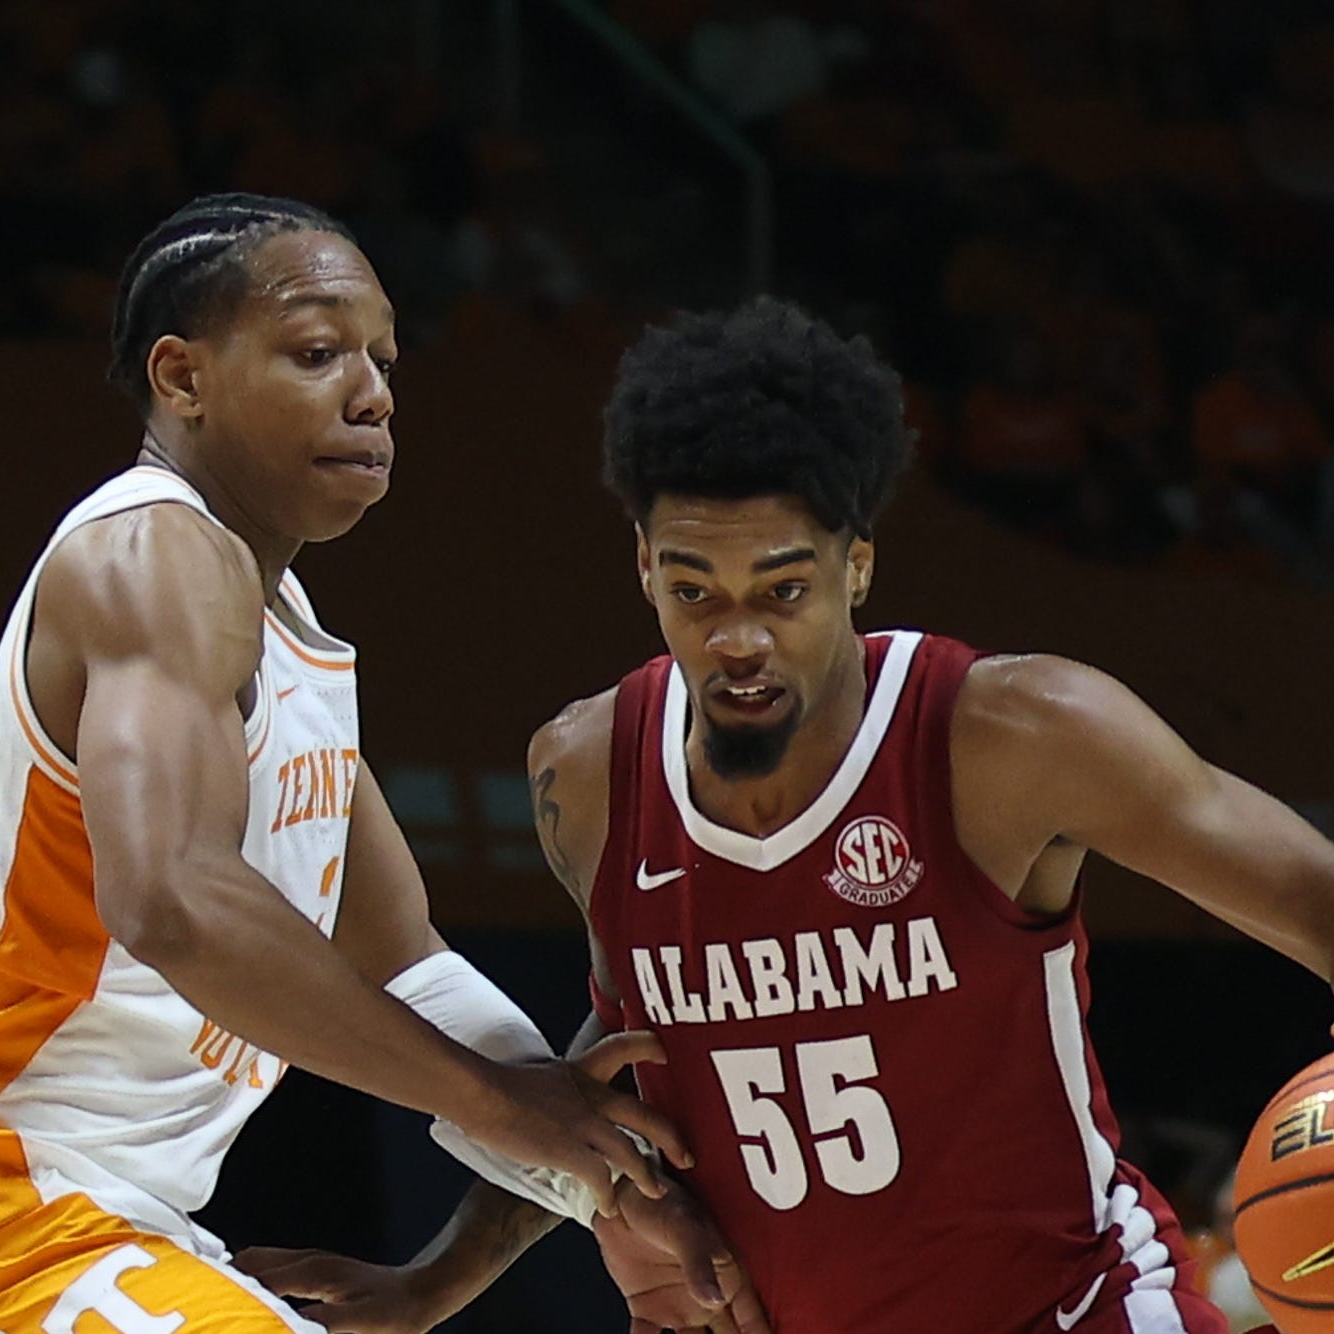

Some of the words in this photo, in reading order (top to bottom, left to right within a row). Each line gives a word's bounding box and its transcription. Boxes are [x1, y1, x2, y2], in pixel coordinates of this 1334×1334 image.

[838, 879, 915, 907] GRADUATE
[841, 821, 904, 885] SEC
[631, 916, 958, 1026] ALABAMA
[710, 1034, 901, 1212] 55
